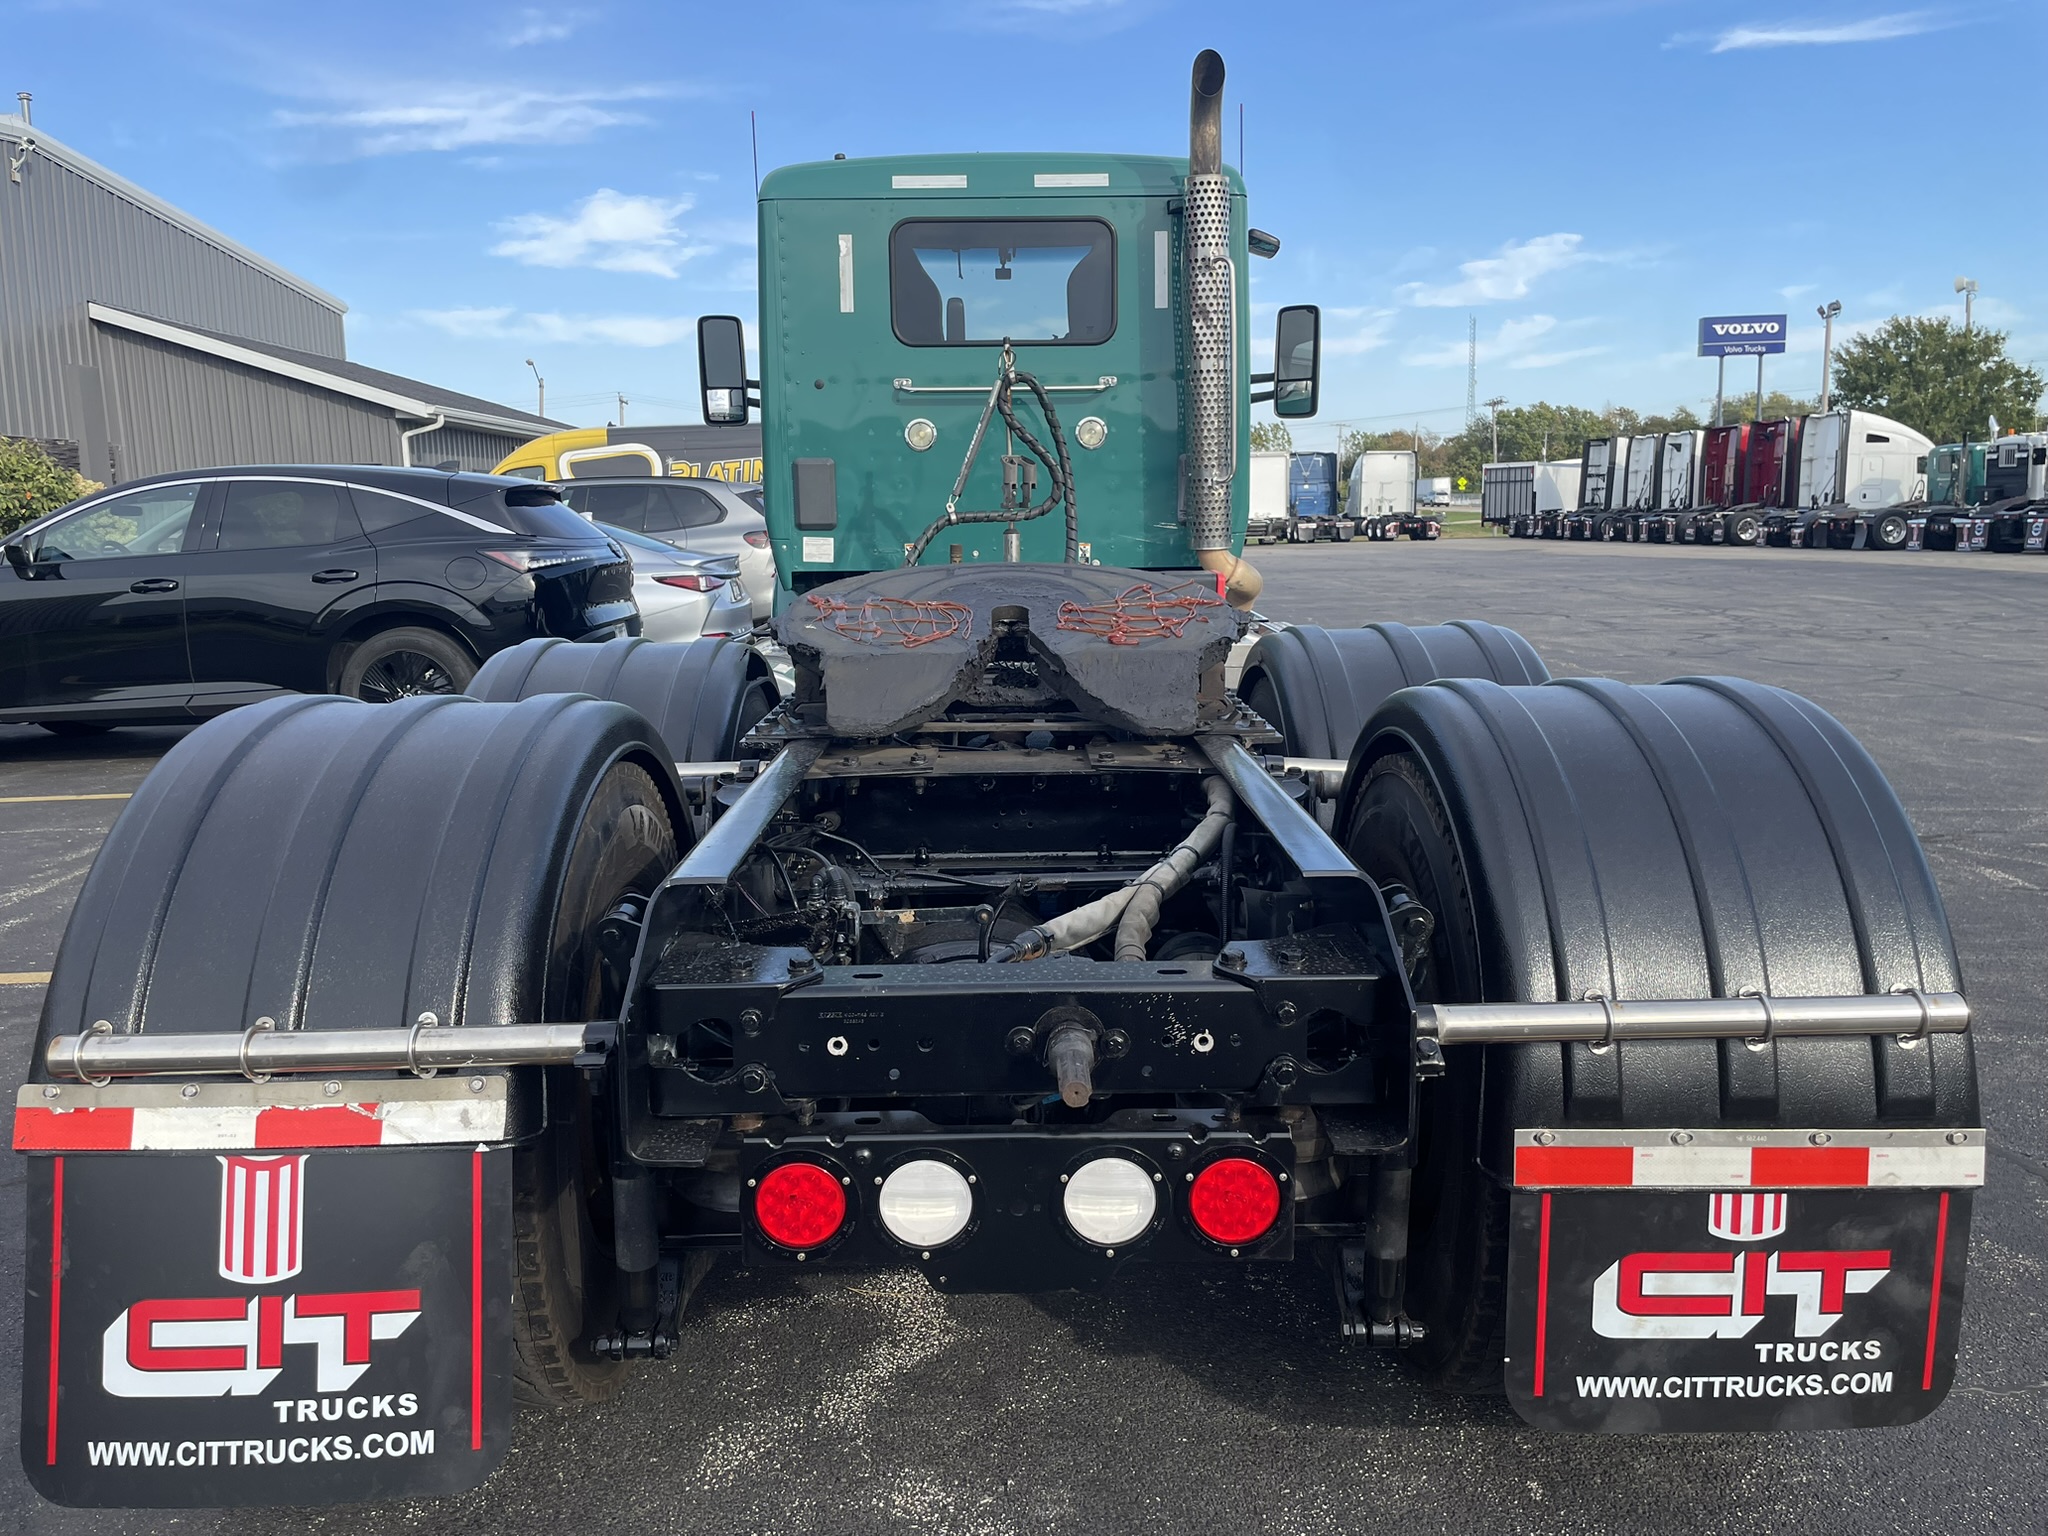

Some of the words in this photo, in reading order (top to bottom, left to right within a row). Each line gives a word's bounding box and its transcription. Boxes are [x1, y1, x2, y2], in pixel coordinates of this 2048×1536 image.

[1712, 322, 1779, 335] VOLVO
[1744, 345, 1766, 353] Trucks
[1592, 1250, 1891, 1339] CIT
[102, 1289, 422, 1397] CIT
[1754, 1340, 1881, 1363] TRUCKS
[1576, 1372, 1893, 1399] WWW.CITTRUCKS.COM
[273, 1393, 419, 1423] TRUCKS
[87, 1430, 435, 1467] WWW.CITTRUCKS.COM
